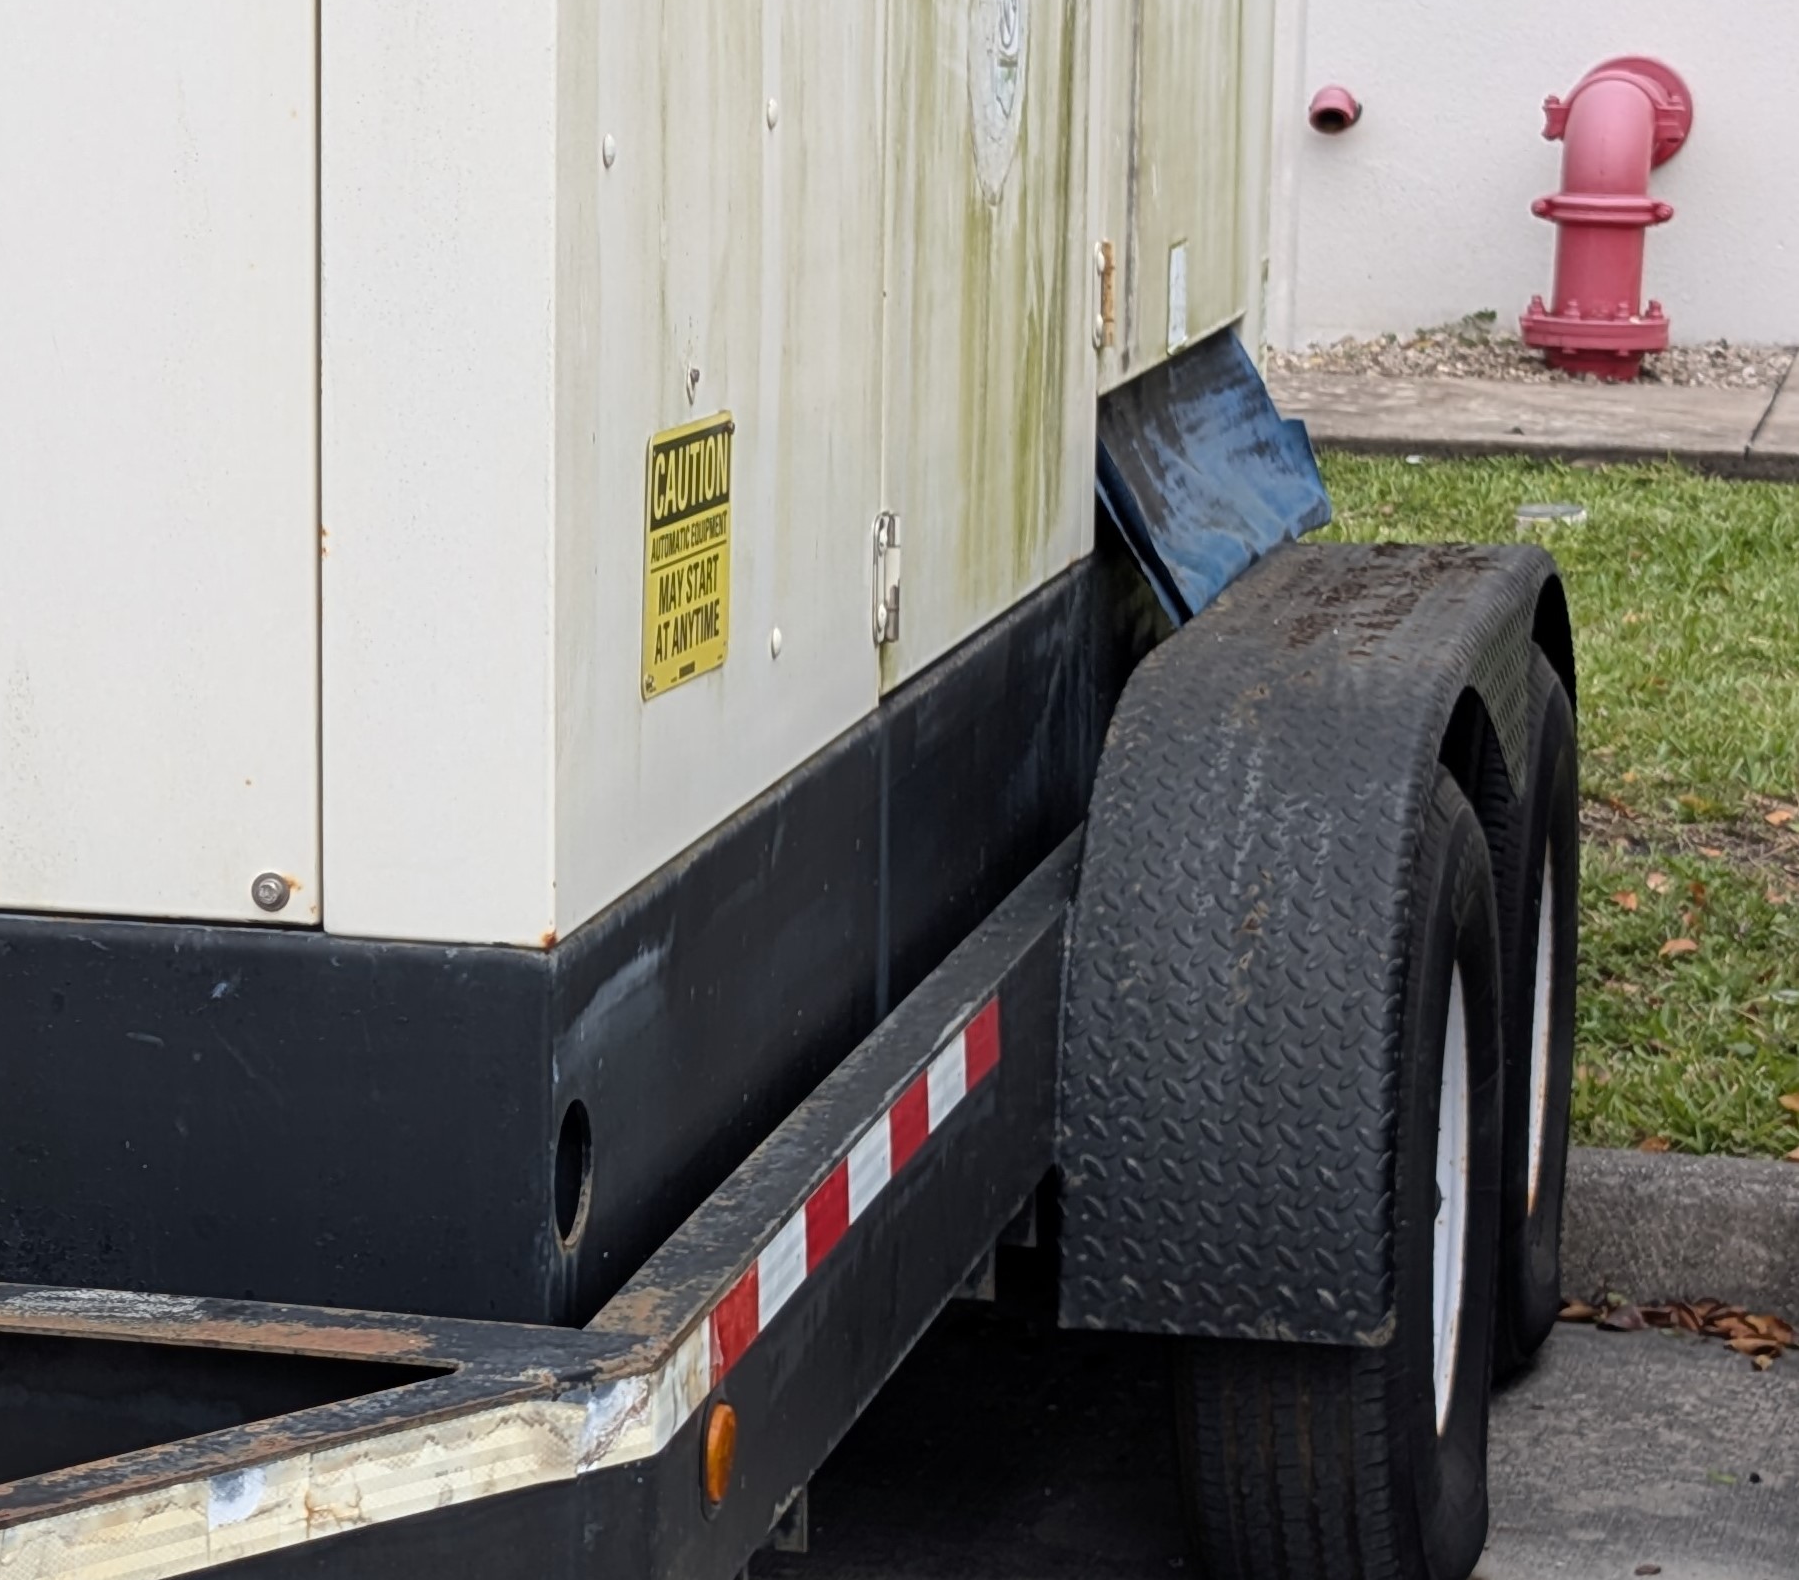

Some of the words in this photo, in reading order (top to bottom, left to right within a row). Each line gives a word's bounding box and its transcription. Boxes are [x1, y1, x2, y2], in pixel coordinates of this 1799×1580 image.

[652, 431, 729, 521] CAUTION
[651, 526, 690, 564] AUTOMATIC
[690, 510, 728, 546] EQUIPMENT
[658, 569, 683, 616] MAY
[686, 553, 720, 604] START
[654, 620, 671, 665] AT
[671, 598, 720, 655] ANYTIME
